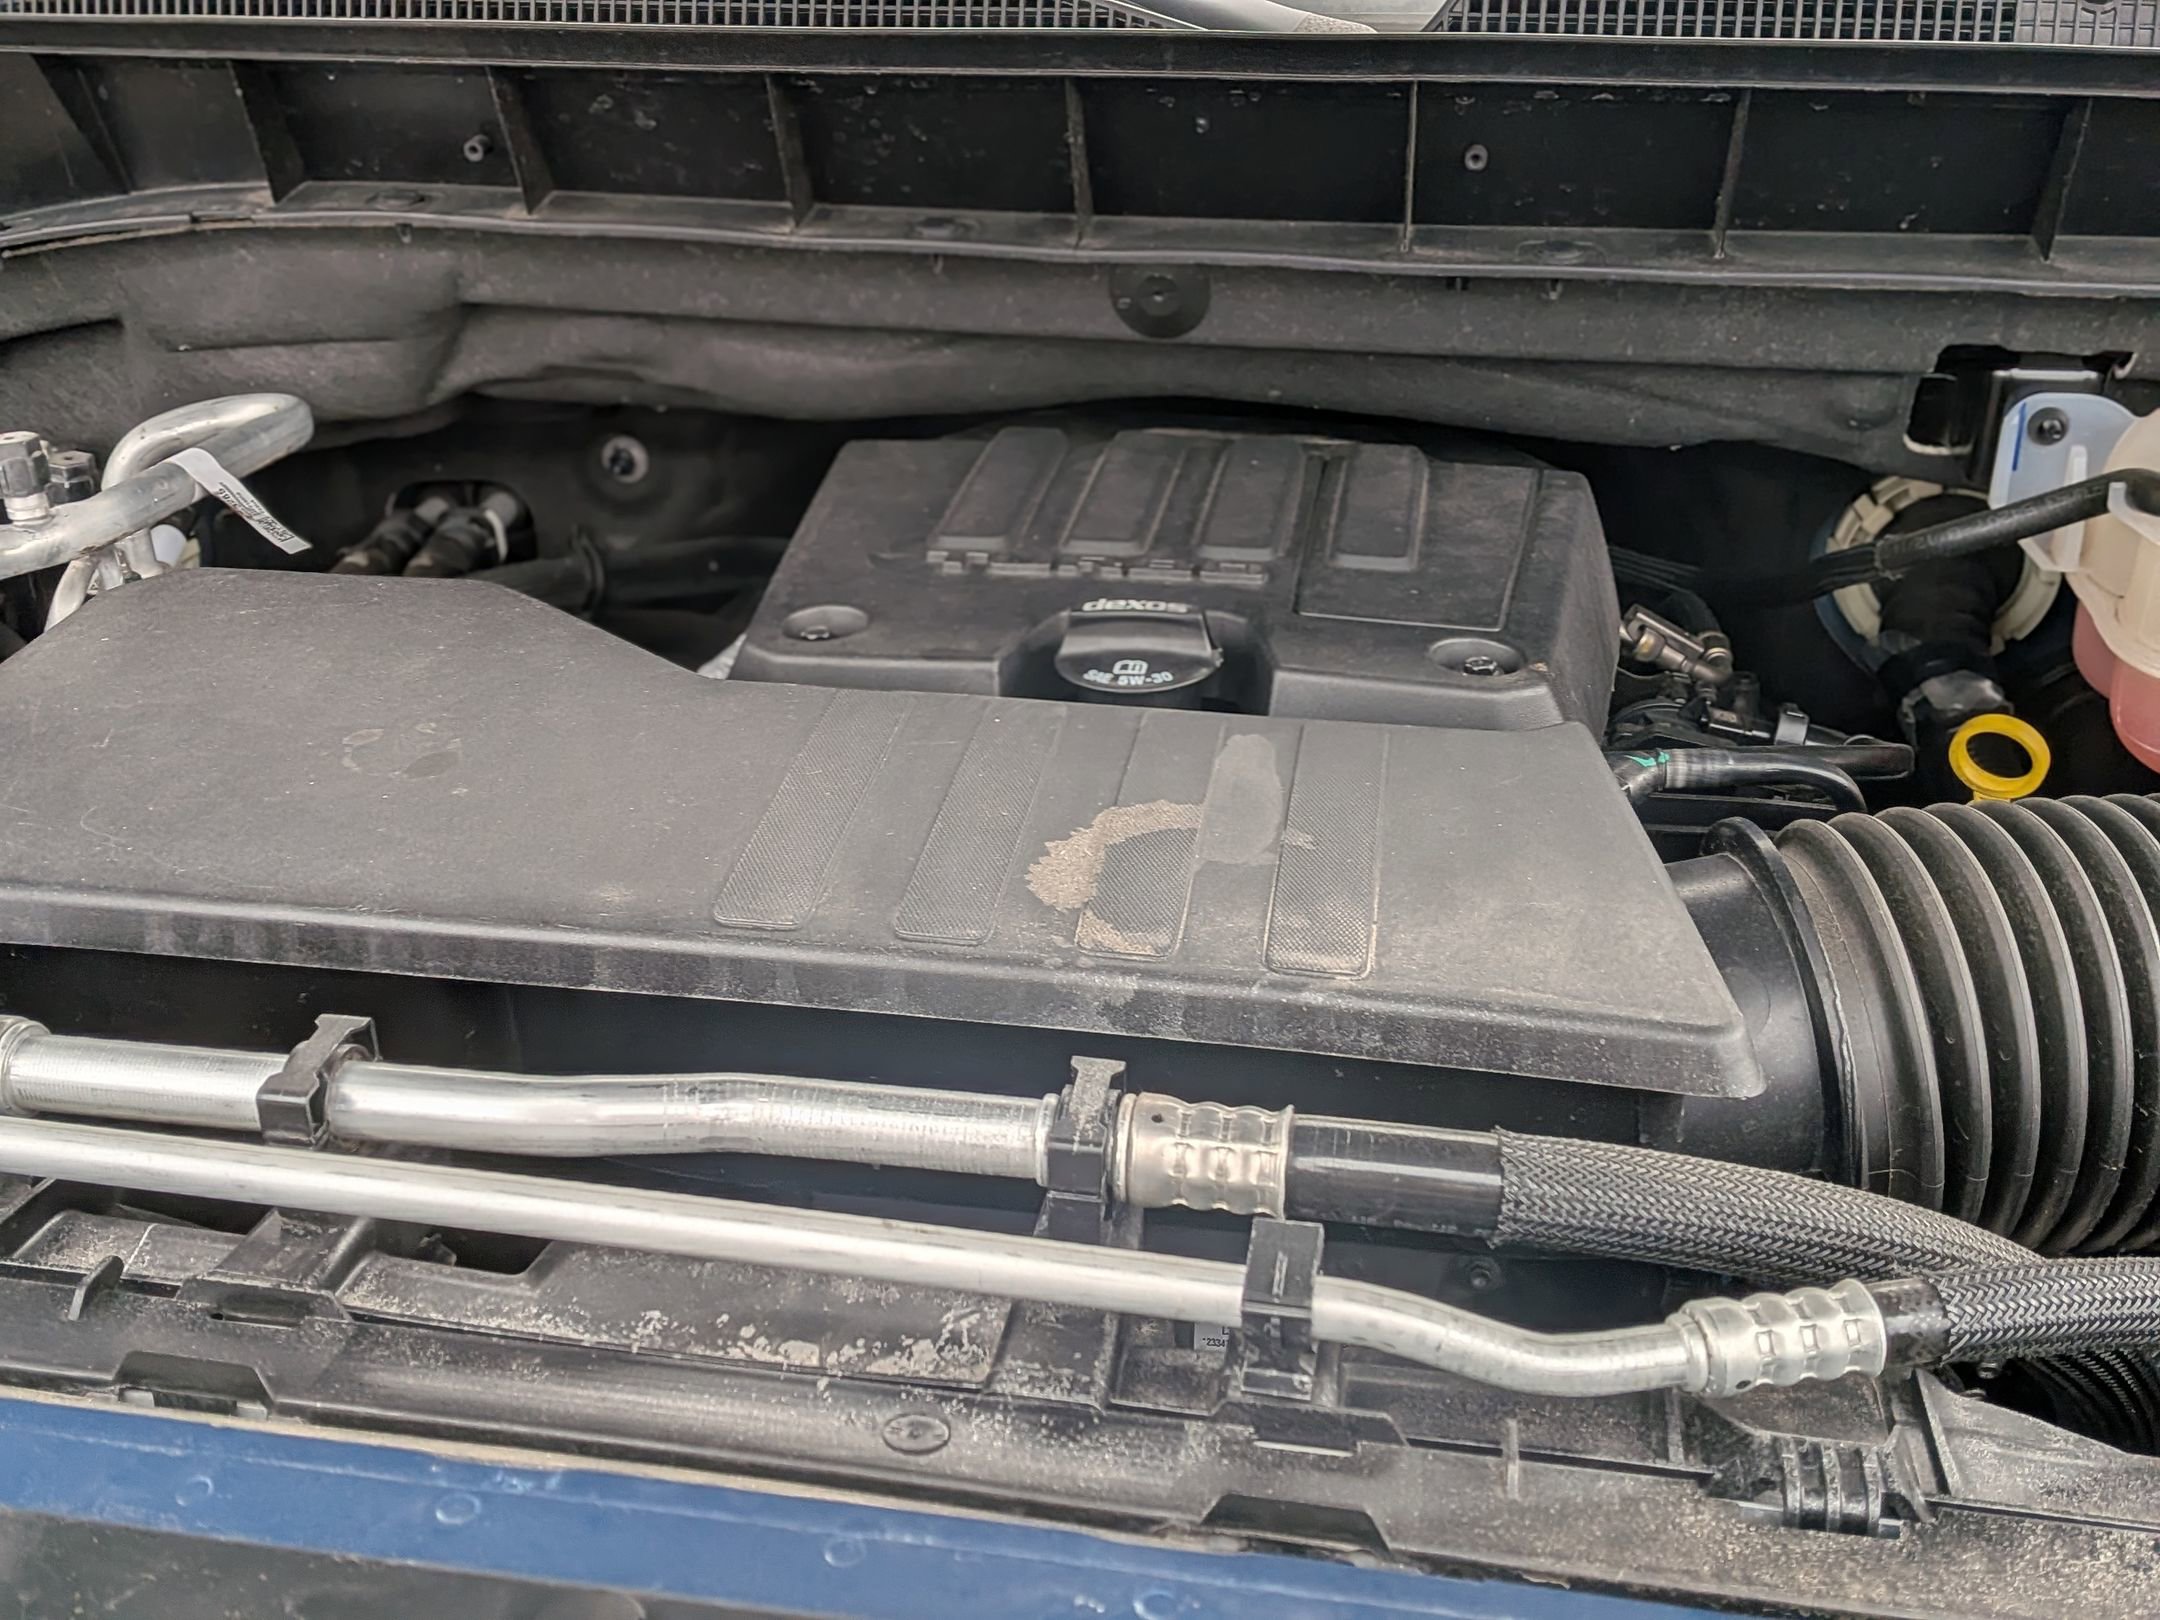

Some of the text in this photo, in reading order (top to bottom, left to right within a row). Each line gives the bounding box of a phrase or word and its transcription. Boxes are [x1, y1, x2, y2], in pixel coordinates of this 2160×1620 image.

[1082, 598, 1188, 614] dexos
[1083, 669, 1174, 686] SAE 5W-30
